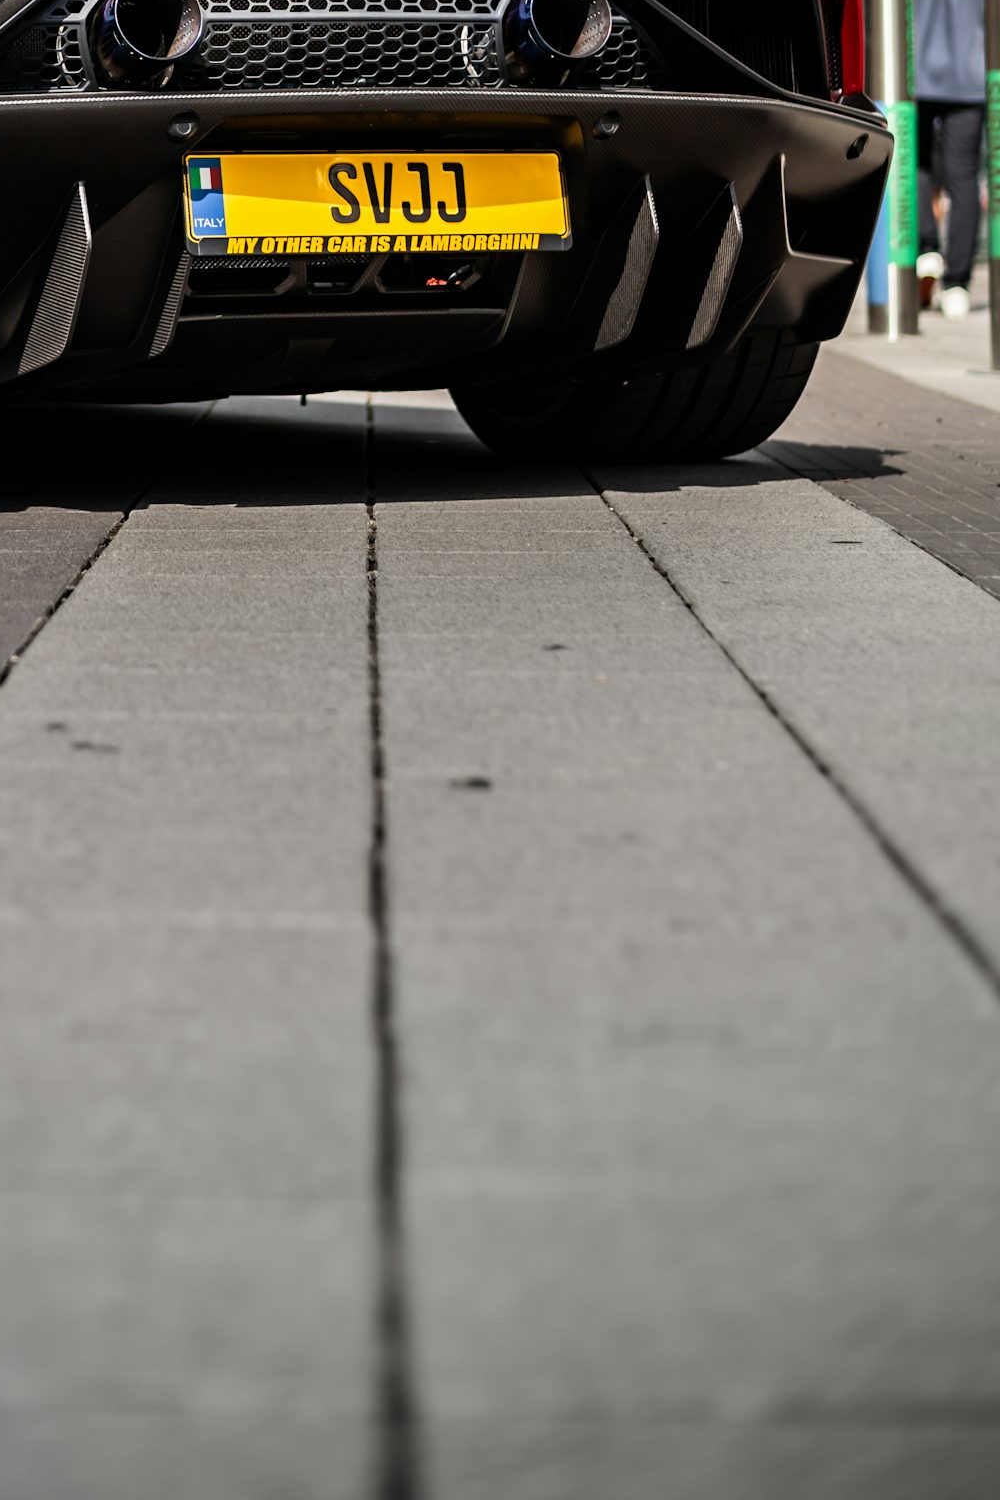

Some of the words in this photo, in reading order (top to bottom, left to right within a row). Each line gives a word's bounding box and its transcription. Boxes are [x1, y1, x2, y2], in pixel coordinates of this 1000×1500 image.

[328, 161, 467, 224] SVJJ
[194, 217, 225, 228] ITALY
[226, 236, 259, 255] MY
[261, 236, 324, 255] OTHER
[327, 235, 367, 253] CAR
[369, 235, 391, 253] IS
[393, 235, 407, 252] A
[410, 233, 541, 252] LAMBORGHINI
